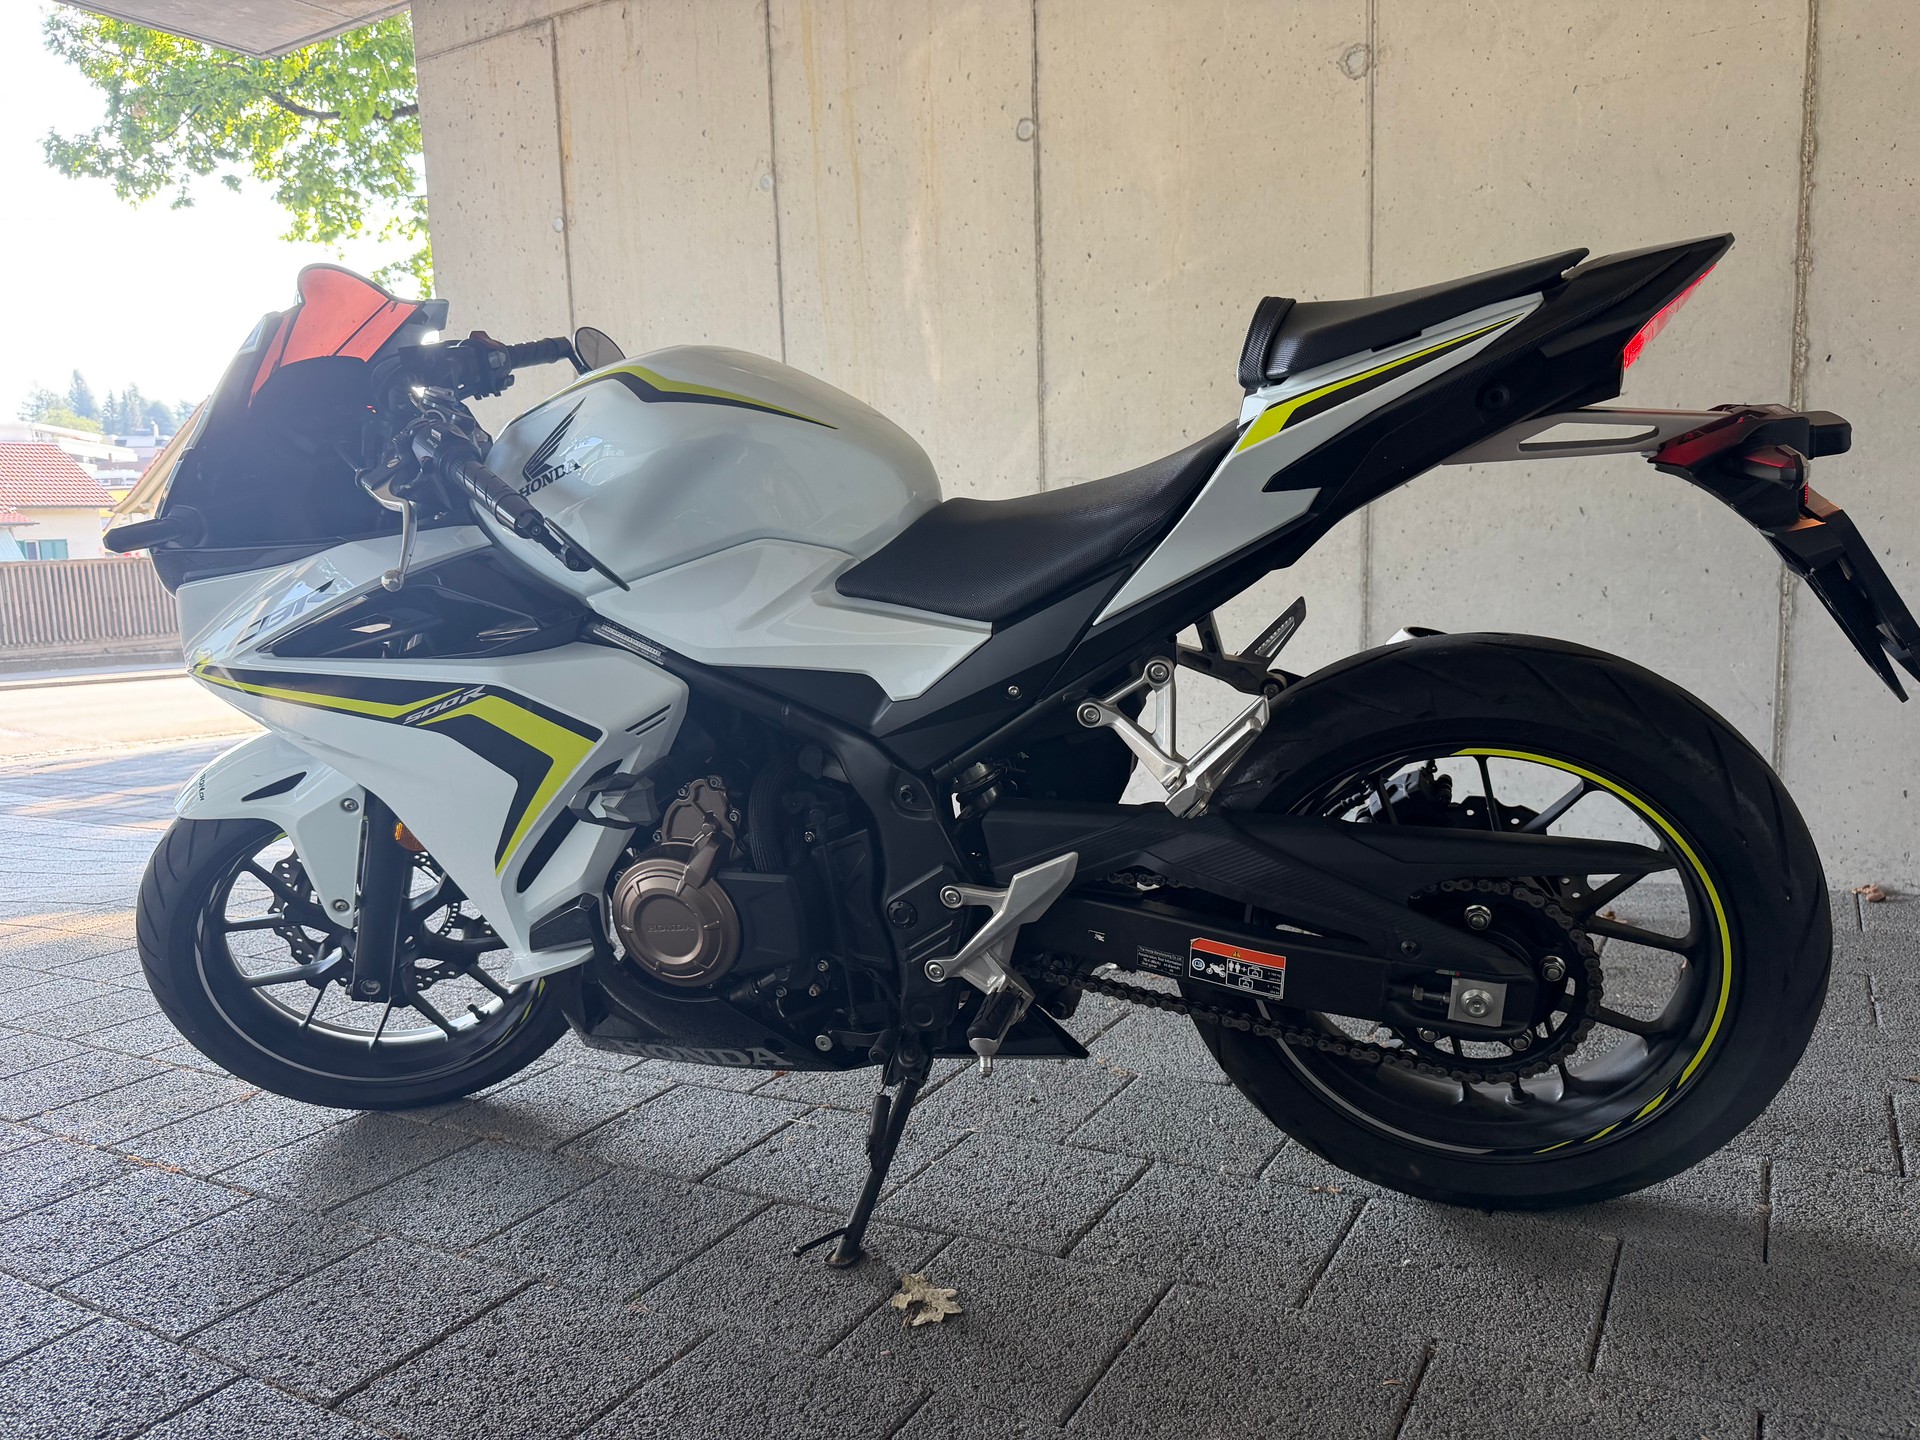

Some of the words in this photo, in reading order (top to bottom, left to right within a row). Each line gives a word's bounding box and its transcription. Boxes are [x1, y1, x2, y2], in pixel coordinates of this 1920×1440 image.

[518, 458, 581, 497] HONDA
[237, 577, 337, 646] CBR
[402, 684, 487, 726] 500R
[646, 922, 695, 933] HONDA
[608, 1038, 794, 1066] HONDA
